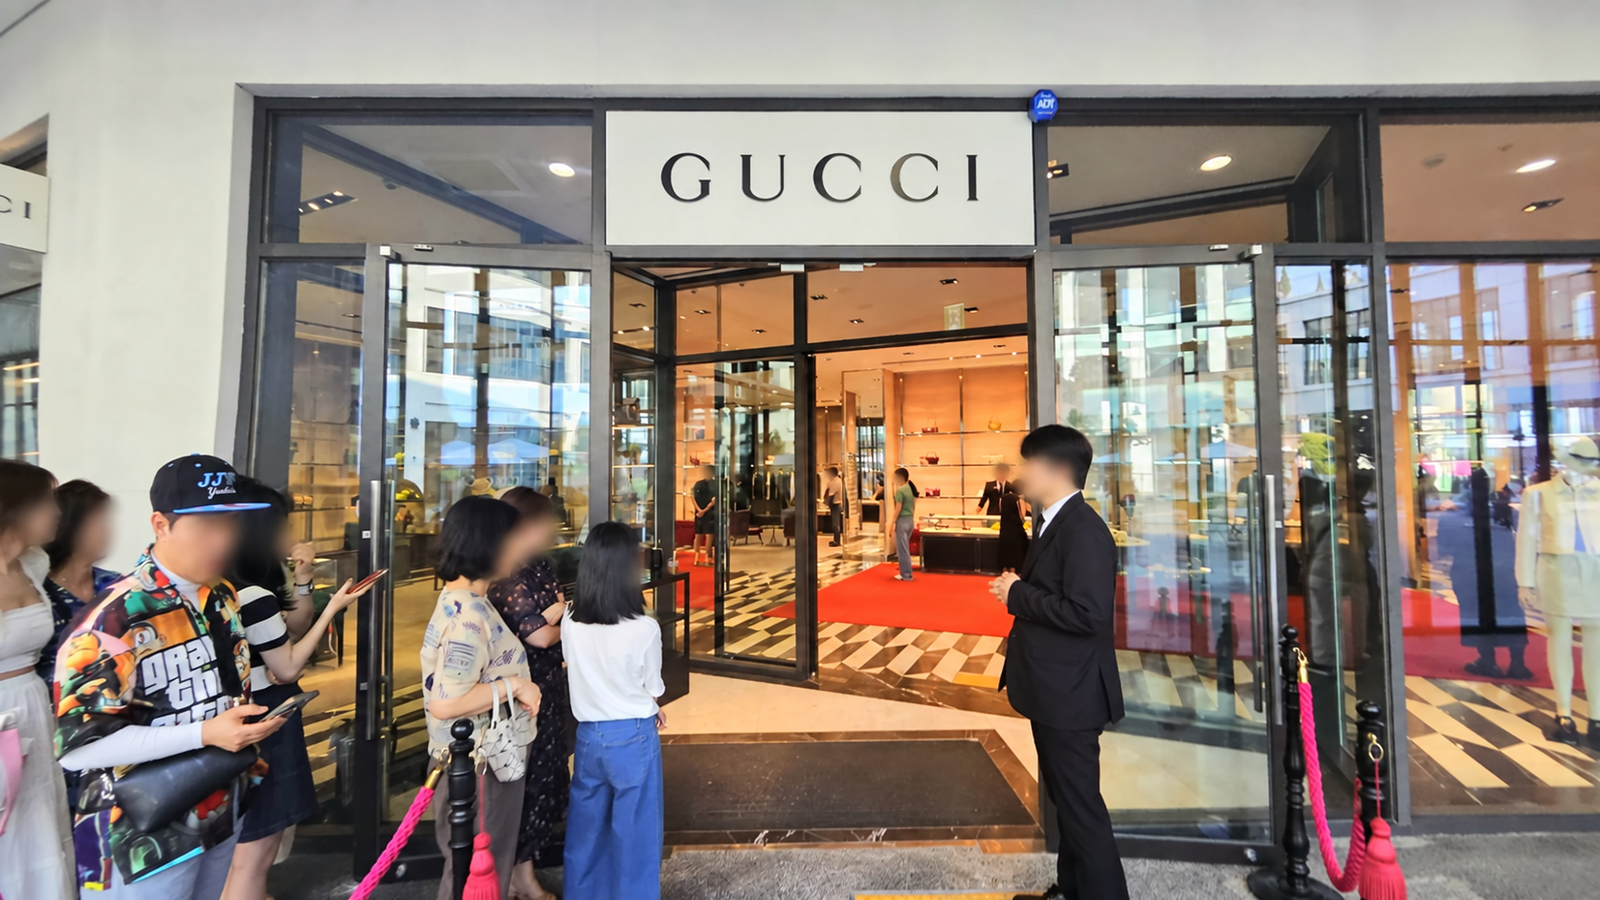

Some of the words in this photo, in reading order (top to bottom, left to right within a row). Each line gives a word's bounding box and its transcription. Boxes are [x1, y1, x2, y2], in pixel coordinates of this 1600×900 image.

[1036, 98, 1055, 109] ADT
[661, 152, 979, 203] GUCCI
[165, 667, 223, 710] th
